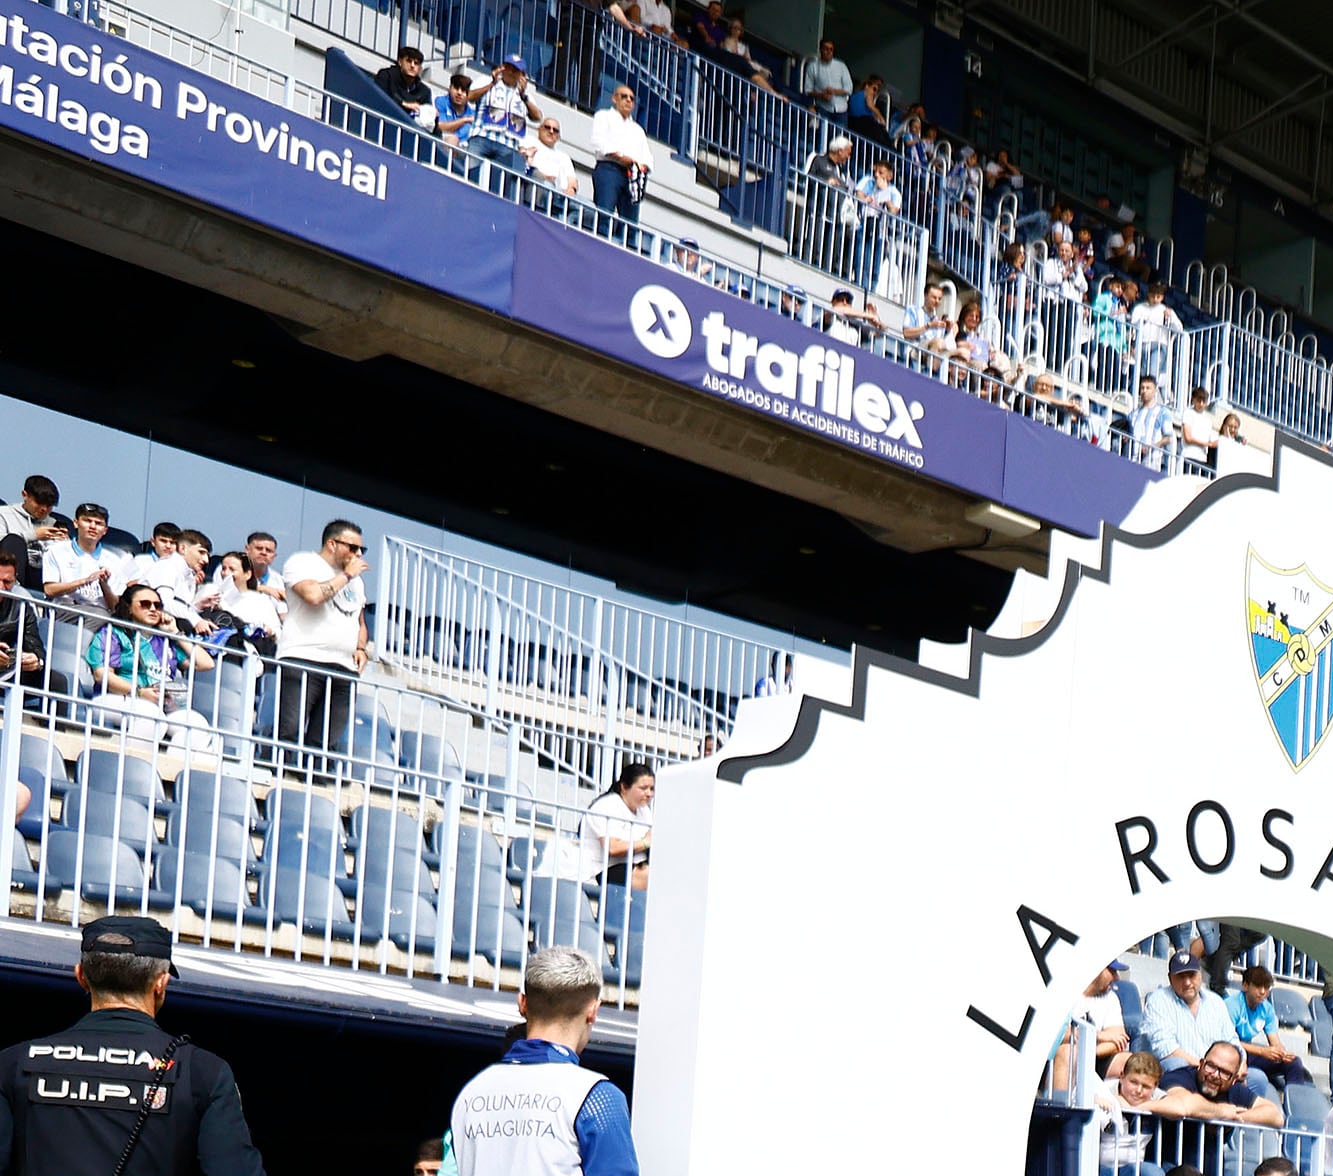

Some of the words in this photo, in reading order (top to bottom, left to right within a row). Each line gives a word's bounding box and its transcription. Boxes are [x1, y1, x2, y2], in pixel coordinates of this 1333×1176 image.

[965, 53, 983, 78] 14
[0, 14, 163, 110] tación
[176, 81, 388, 201] Provincial
[1274, 199, 1286, 216] A
[700, 311, 925, 449] trafilex
[702, 372, 771, 410] ABOGADOS
[773, 398, 789, 417] DE
[791, 406, 860, 444] ACCIDENTES
[862, 434, 877, 450] DE
[879, 440, 925, 469] TRÁFICO
[1291, 586, 1311, 606] TM
[966, 903, 1080, 1054] LA
[28, 1044, 155, 1066] POLICIA
[37, 1077, 138, 1105] U.I.P.
[464, 1093, 562, 1112] VOLUNTARIO
